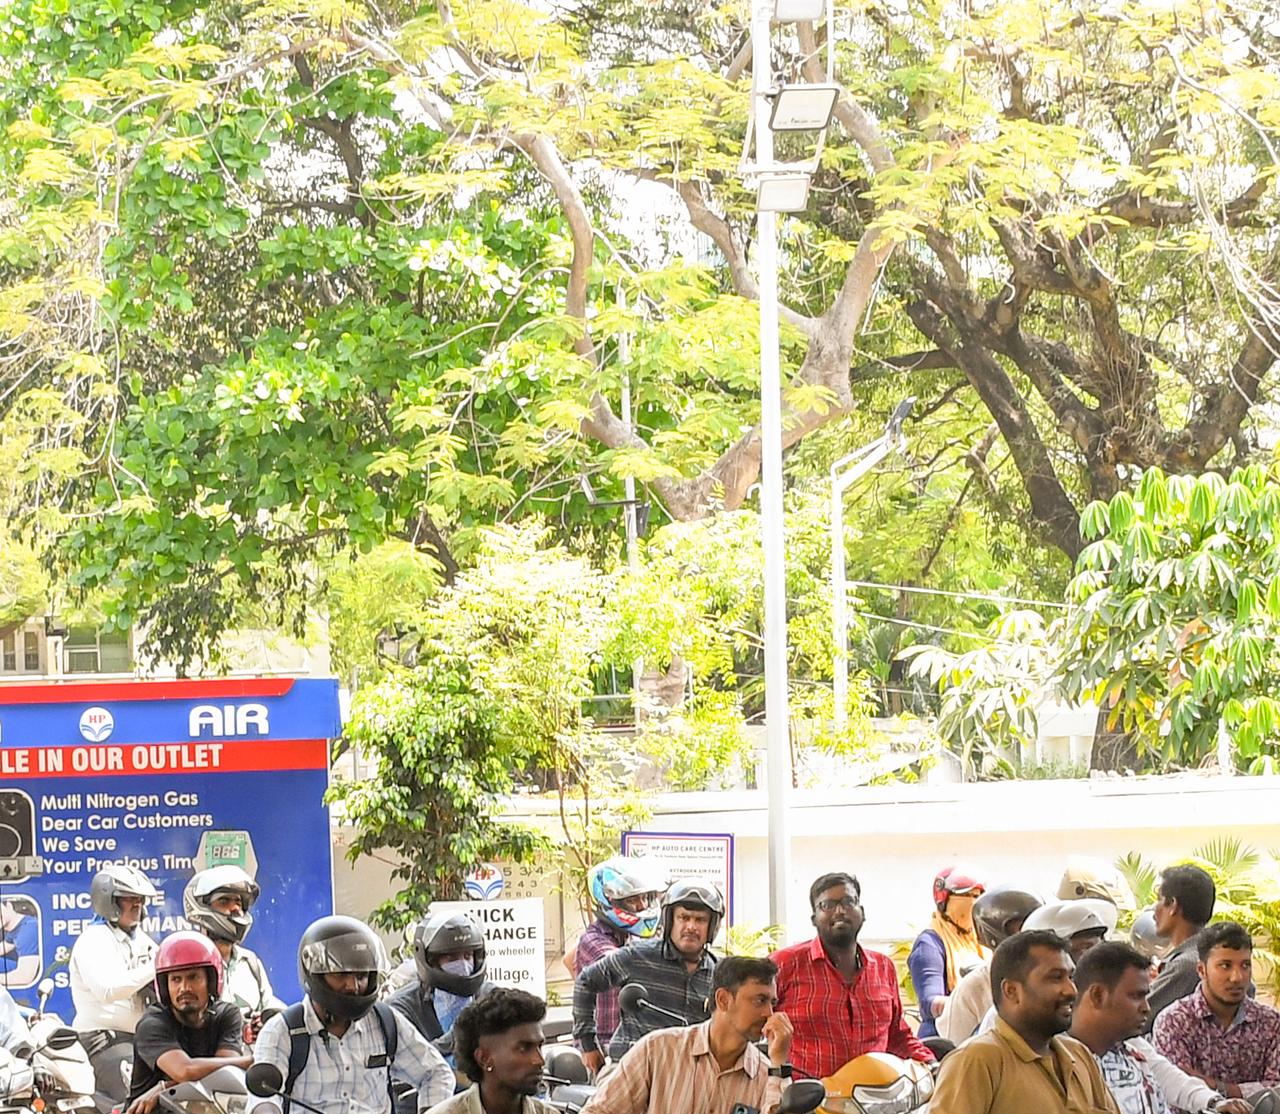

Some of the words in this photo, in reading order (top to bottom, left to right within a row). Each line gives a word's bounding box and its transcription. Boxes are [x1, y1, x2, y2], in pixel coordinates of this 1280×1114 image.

[88, 714, 107, 725] HP
[188, 703, 270, 738] AIR
[38, 748, 64, 773] IN
[71, 747, 124, 772] OUR
[132, 744, 224, 770] OUTLET
[41, 793, 82, 811] Multi
[86, 791, 159, 812] Nitrogen
[164, 790, 199, 807] Gas
[41, 815, 83, 832] Dear
[87, 814, 119, 831] Car
[123, 812, 213, 830] Customers
[42, 837, 69, 853] We
[74, 835, 117, 852] Save
[43, 858, 82, 874] Your
[484, 926, 537, 941] HANGE
[498, 946, 536, 956] wheeler
